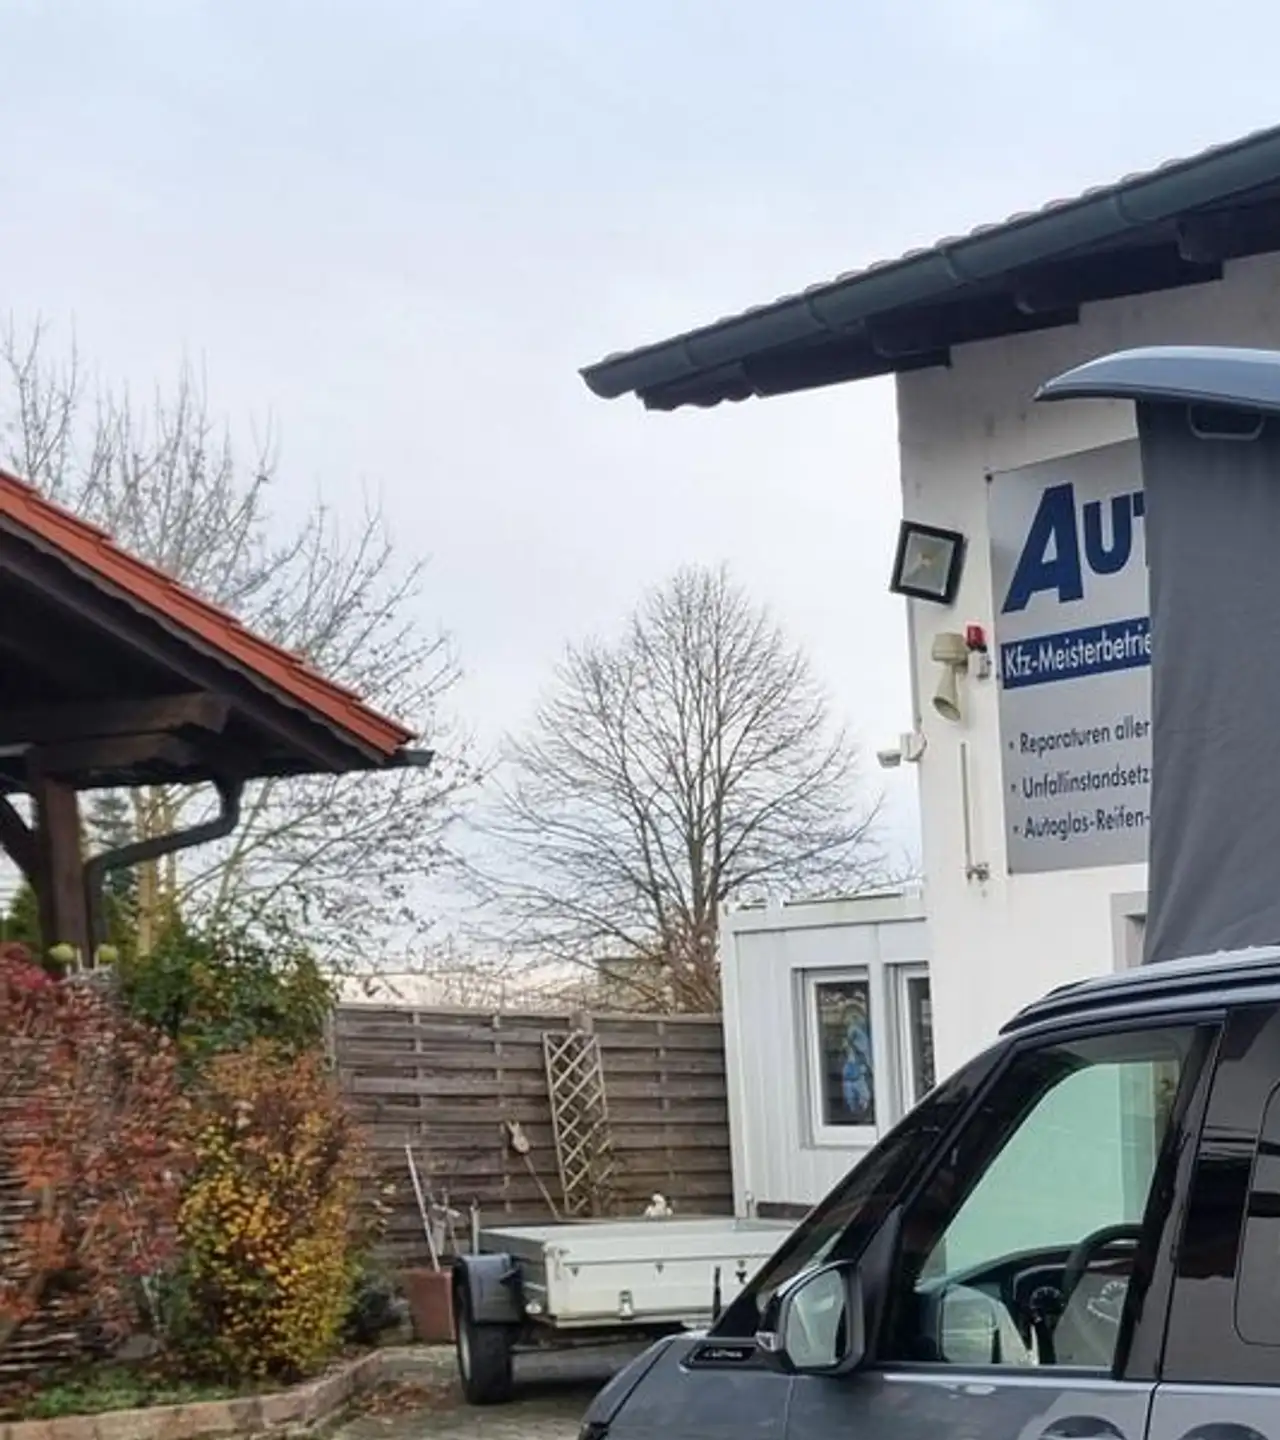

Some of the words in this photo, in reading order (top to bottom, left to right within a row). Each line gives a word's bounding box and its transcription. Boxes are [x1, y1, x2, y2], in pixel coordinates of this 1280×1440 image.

[1004, 625, 1151, 679] Kfz-Meisterbetrie
[1020, 725, 1110, 758] Reparaturen
[1115, 714, 1150, 741] aller
